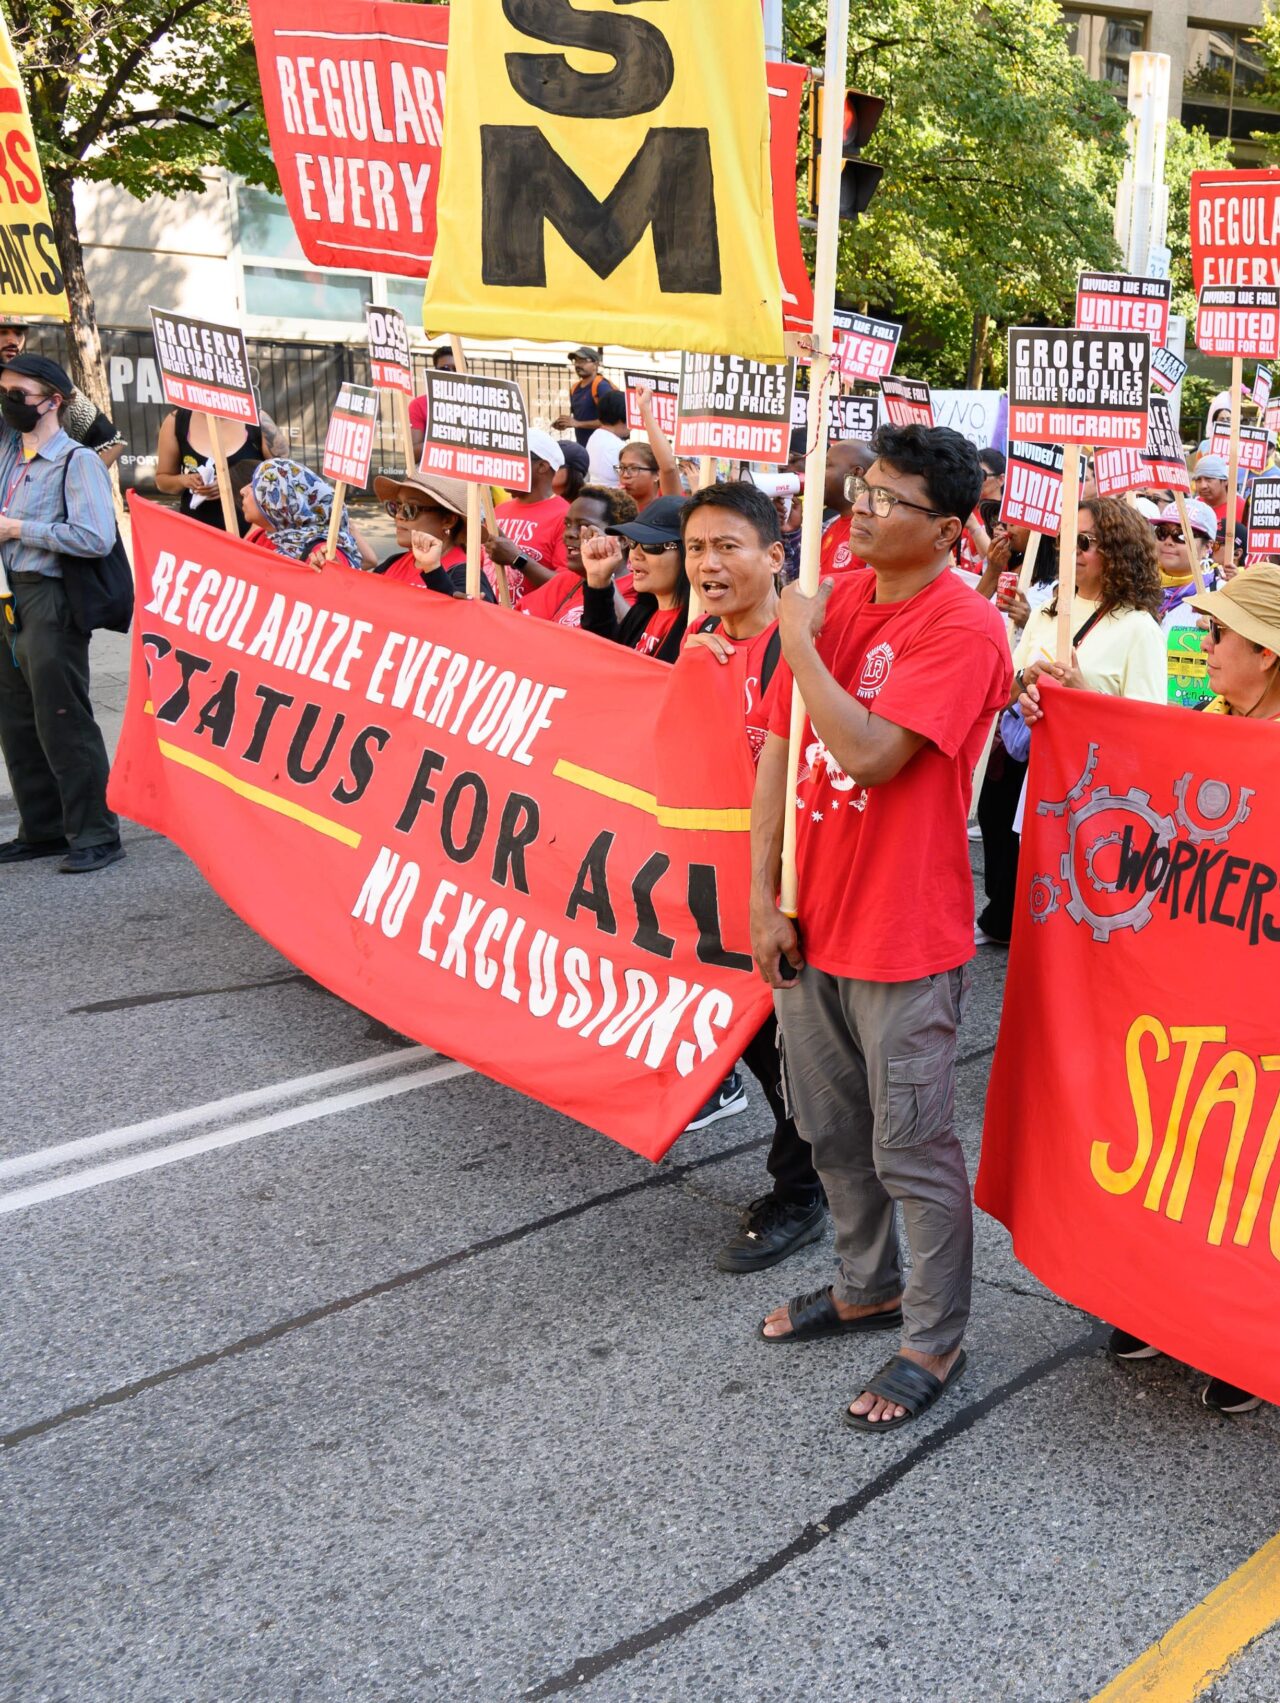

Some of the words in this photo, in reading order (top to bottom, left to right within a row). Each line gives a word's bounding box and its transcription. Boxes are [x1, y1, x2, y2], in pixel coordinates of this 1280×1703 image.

[1083, 278, 1119, 293] DIVIDED
[1123, 282, 1140, 294] WE
[1142, 283, 1165, 297] FALL
[1203, 291, 1236, 304] DIVIDED
[1238, 292, 1254, 305] WE
[1256, 292, 1277, 305] FALL
[1081, 298, 1162, 330] UNITED
[1201, 312, 1275, 340] UNITED
[156, 317, 240, 360] GROCERY
[853, 319, 870, 335] WE
[872, 325, 895, 341] FALL
[159, 342, 243, 376] MONOPOLIES
[1016, 339, 1144, 371] GROCERY
[1200, 339, 1213, 349] WE
[1216, 340, 1234, 352] WIN
[1238, 340, 1256, 353] FOR
[1258, 341, 1274, 354] ALL
[192, 366, 214, 380] FOOD
[217, 371, 246, 388] PRICES
[845, 360, 864, 375] FOR
[1016, 367, 1143, 392] MONOPOLIES
[166, 380, 184, 400] NOT
[187, 383, 251, 416] MIGRANTS
[432, 379, 509, 409] BILLIONAIRES
[512, 390, 520, 411] &
[707, 394, 734, 411] FOOD
[740, 397, 784, 415] PRICES
[1016, 386, 1058, 401] INFLATE
[1062, 388, 1095, 404] FOOD
[1100, 390, 1142, 406] PRICES
[432, 401, 523, 434] CORPORATIONS
[1016, 412, 1044, 434] NOT
[1050, 413, 1141, 440] MIGRANTS
[432, 424, 467, 442] DESTROY
[469, 429, 489, 446] THE
[492, 434, 524, 452] PLANET
[839, 430, 873, 441] WAGES
[428, 447, 454, 469] NOT
[457, 452, 525, 482] MIGRANTS
[1007, 502, 1023, 520] WE
[1024, 508, 1042, 525] WIN
[1043, 515, 1059, 531] FOR
[1251, 533, 1271, 548] NOT
[144, 551, 373, 691] REGULARIZE
[366, 632, 567, 766] EVERYONE
[396, 748, 540, 895] FOR
[564, 830, 753, 973] ALL
[351, 846, 420, 939] NO
[419, 879, 734, 1078] EXCLUSIONS
